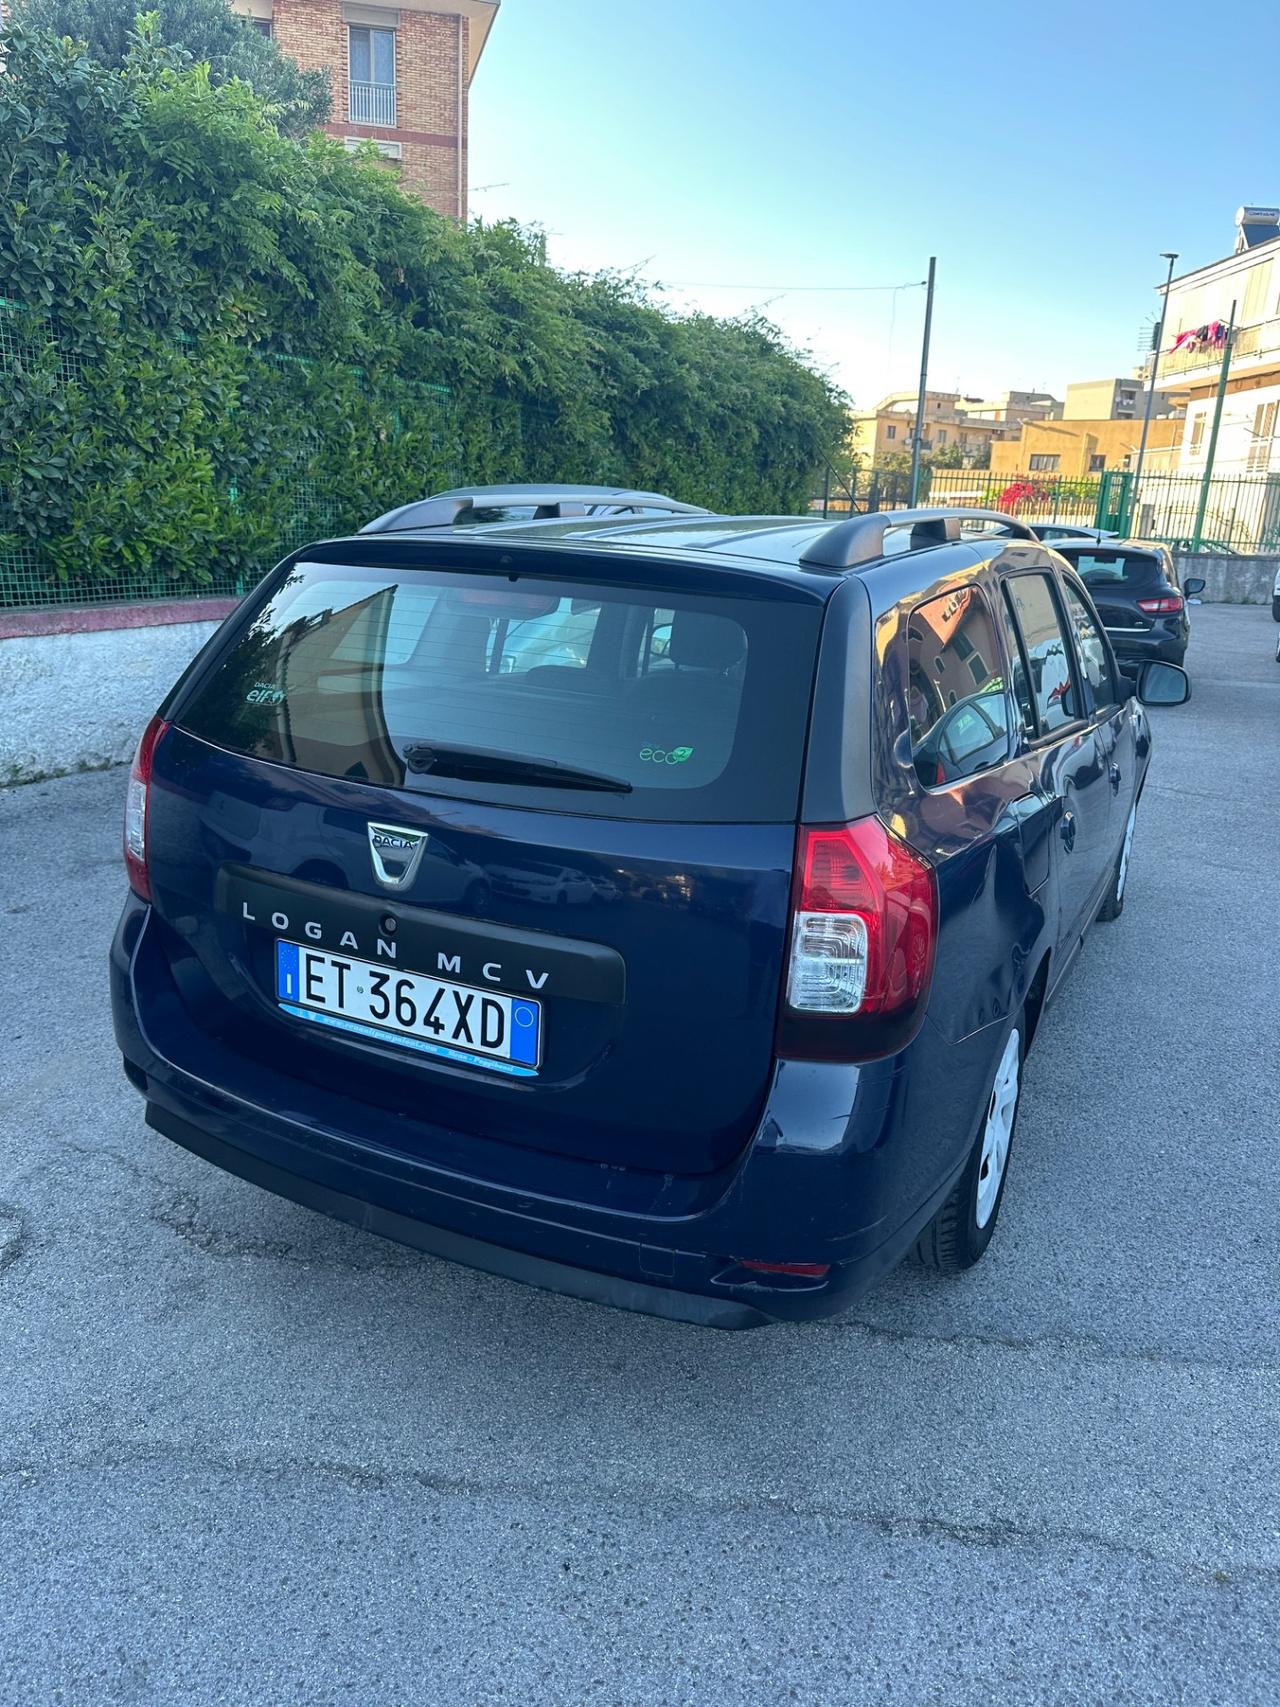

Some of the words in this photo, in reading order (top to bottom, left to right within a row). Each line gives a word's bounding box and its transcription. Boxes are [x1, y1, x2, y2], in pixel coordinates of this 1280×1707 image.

[246, 689, 273, 703] elf
[372, 834, 413, 850] DACIA
[242, 901, 397, 959] LOGAN
[437, 952, 549, 989] MCV
